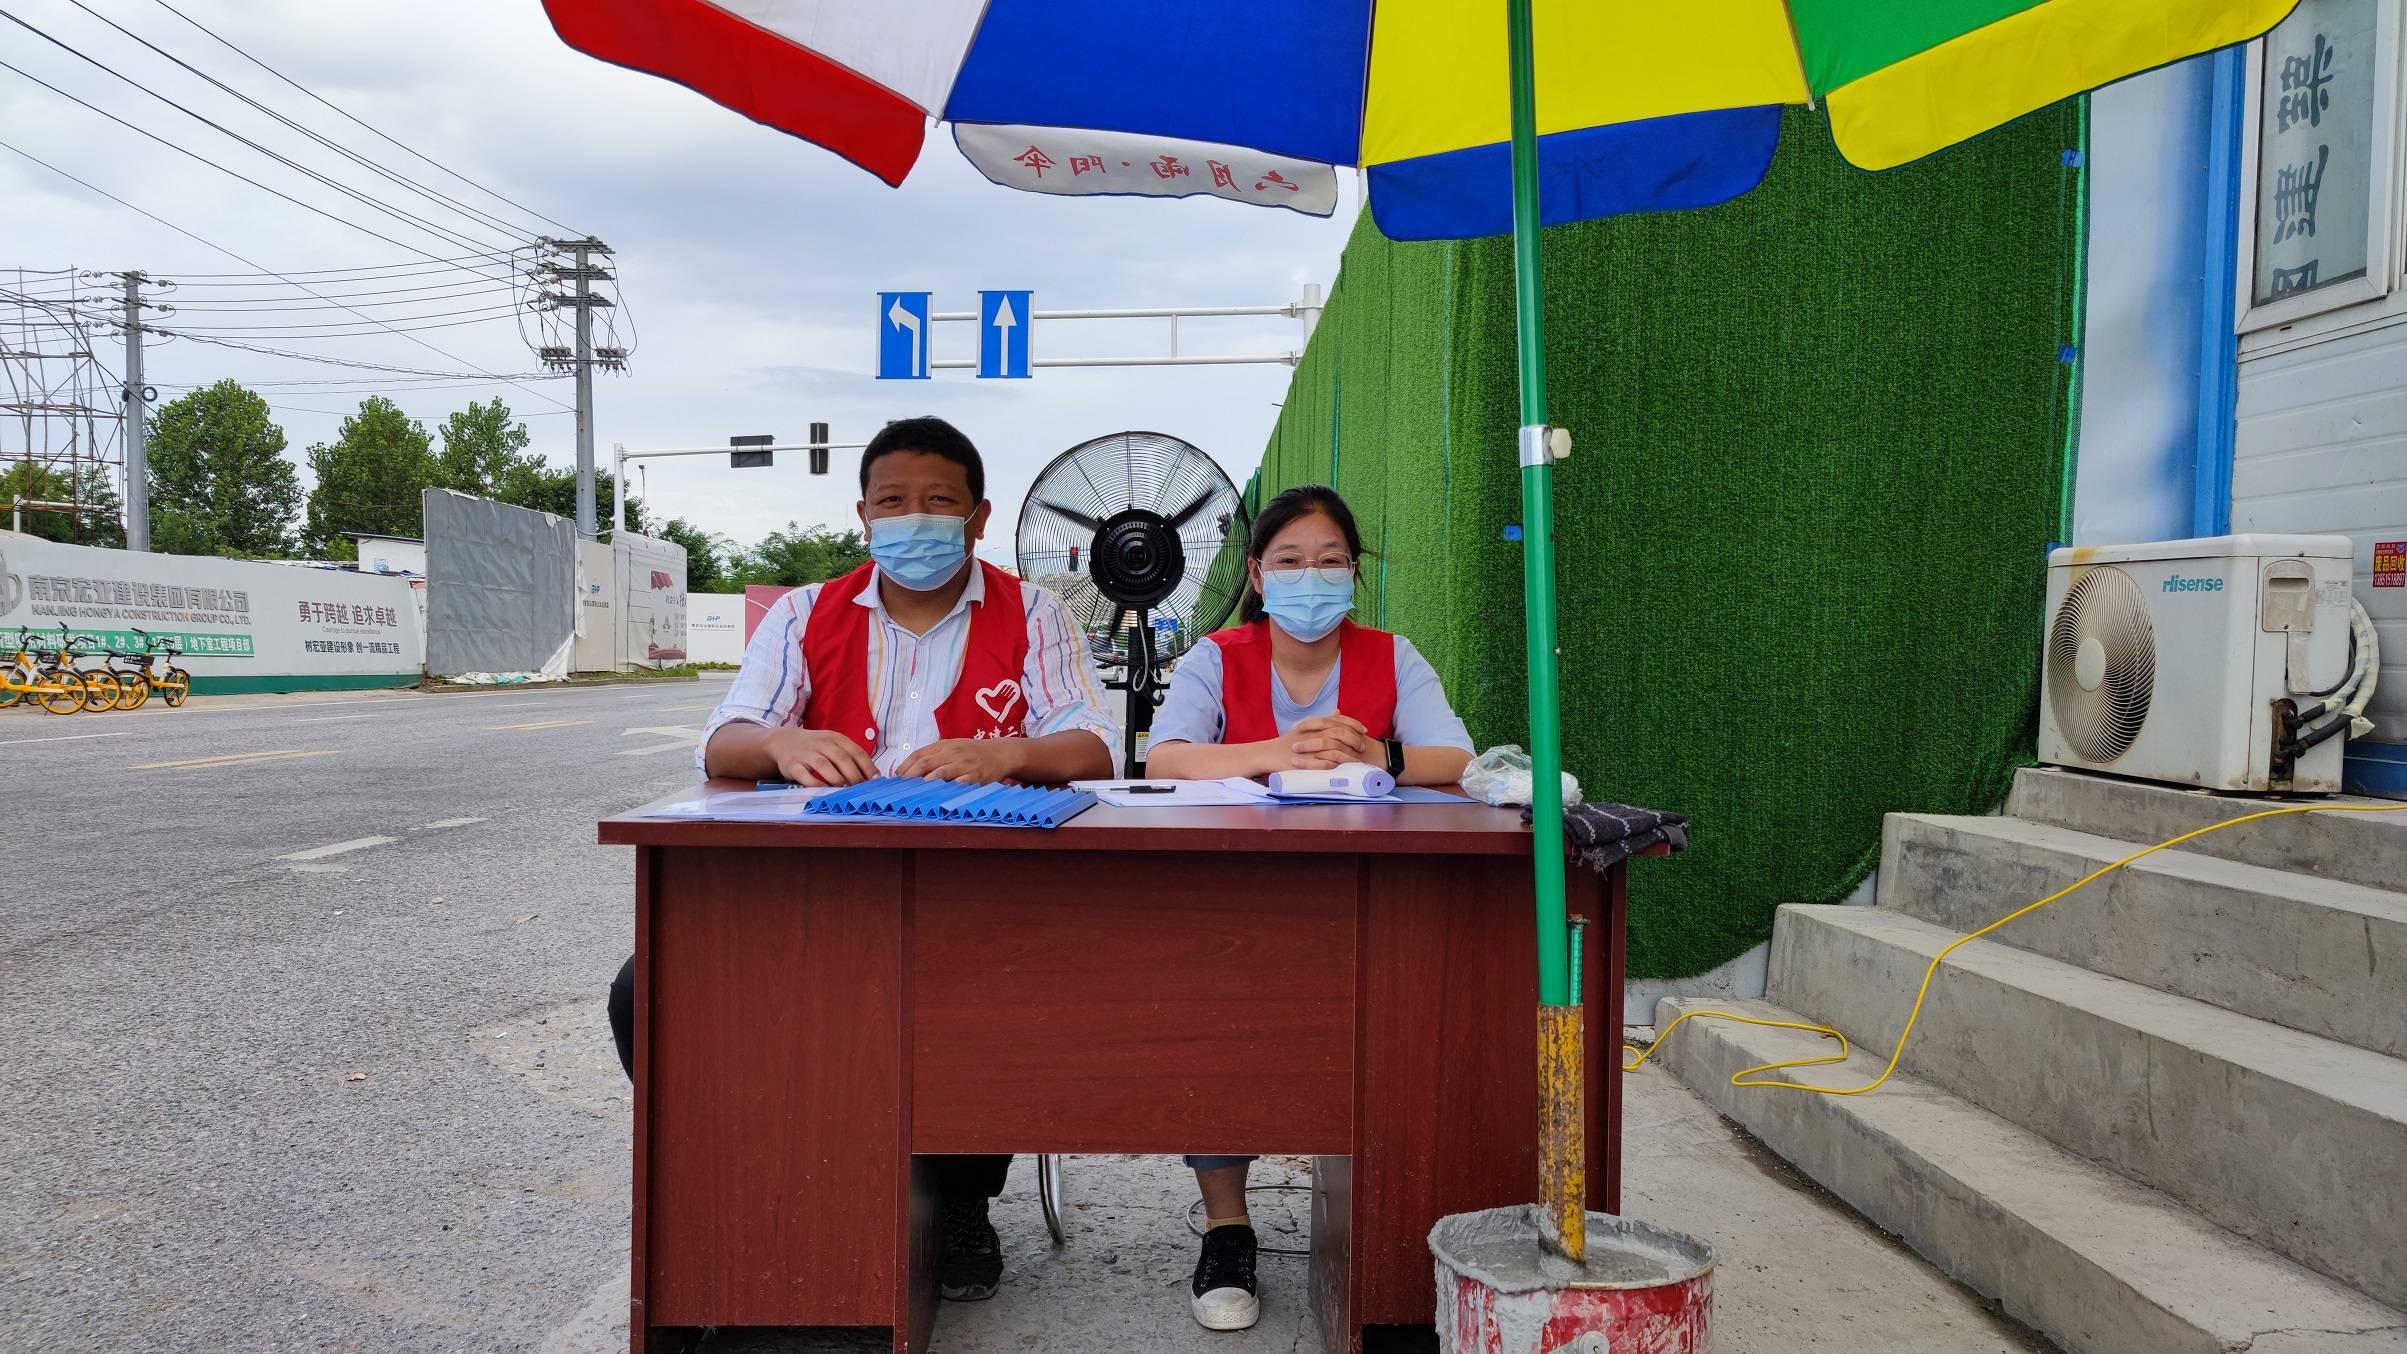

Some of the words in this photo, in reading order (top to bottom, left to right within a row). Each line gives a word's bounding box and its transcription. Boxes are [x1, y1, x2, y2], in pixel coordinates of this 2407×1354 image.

[2375, 554, 2405, 572] 废品回收
[2162, 574, 2224, 592] Hisense
[27, 574, 249, 614] 南京宏亚建设集团有限公司
[32, 604, 77, 617] NANJING
[79, 607, 121, 619] HONGYA
[122, 609, 190, 622] CONSTRUCTION
[191, 612, 217, 624] GROUP
[298, 600, 349, 625] 勇于跨越
[352, 604, 398, 627] 追求卓越
[305, 640, 354, 653] 树宏亚建设形象
[356, 641, 400, 654] 创一流精品工程
